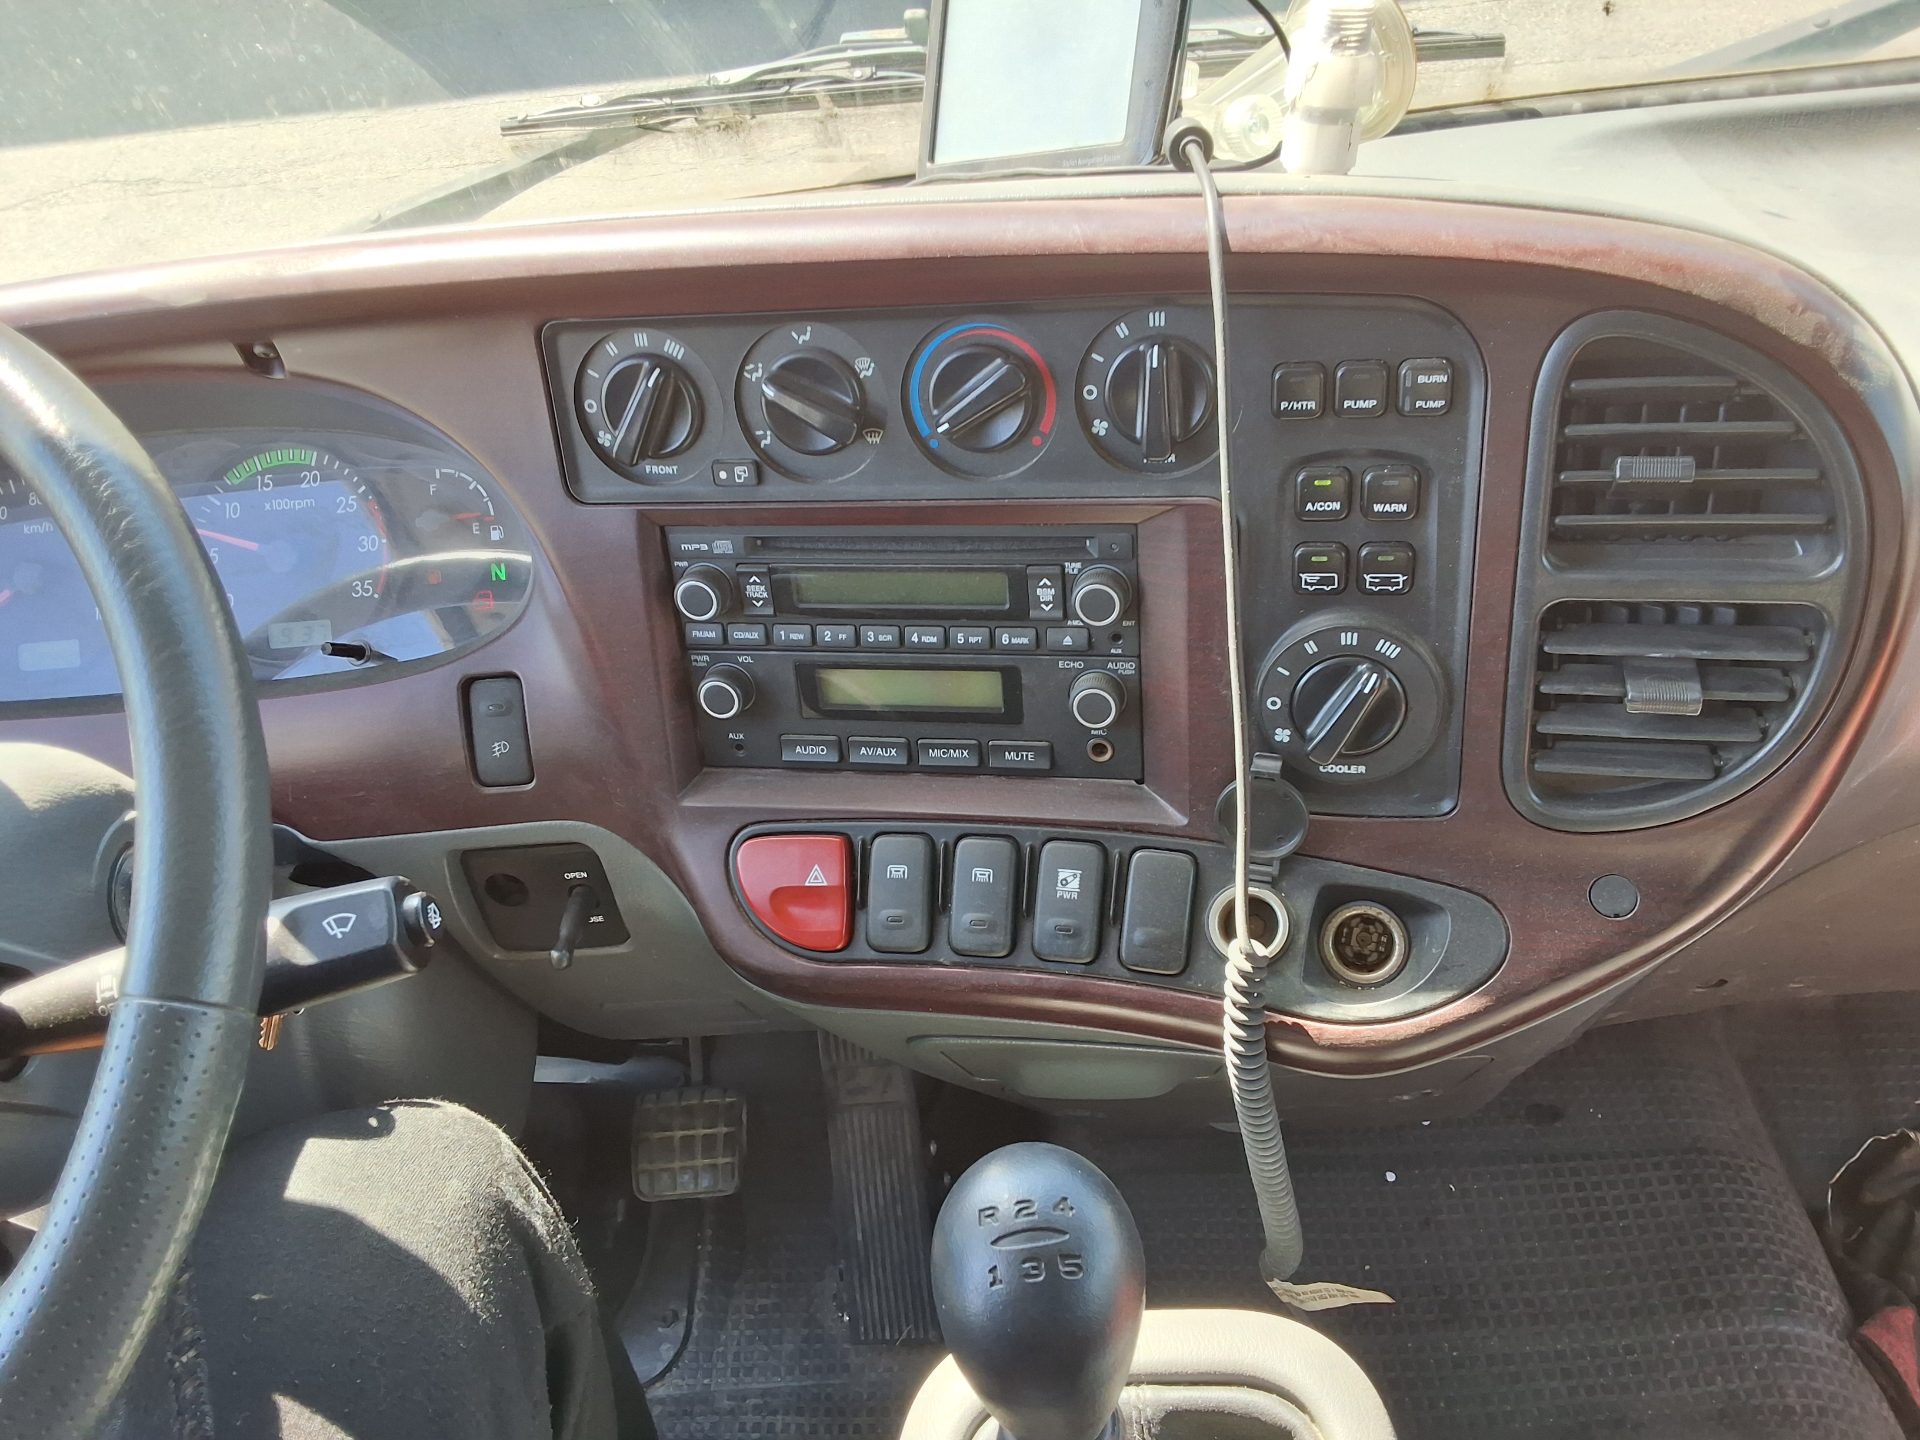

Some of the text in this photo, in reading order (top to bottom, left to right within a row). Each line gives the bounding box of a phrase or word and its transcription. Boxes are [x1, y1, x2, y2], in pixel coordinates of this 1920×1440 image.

[1417, 374, 1448, 384] BURN
[1280, 400, 1316, 411] P/HTR
[1343, 399, 1377, 409] PUMP
[1415, 400, 1446, 409] PUMP
[645, 465, 678, 475] FRONT
[256, 475, 273, 492] 15
[300, 471, 321, 488] 20
[429, 483, 437, 496] F
[264, 498, 315, 511] x100rpm
[336, 496, 357, 513] 25
[1305, 501, 1341, 511] A/CON
[1373, 503, 1408, 513] WARN
[225, 502, 240, 519] 10
[23, 521, 54, 535] km/h
[472, 522, 480, 534] E
[358, 535, 379, 552] 30
[490, 562, 507, 581] N
[351, 581, 373, 598] 35
[745, 591, 768, 599] TRACK
[733, 631, 760, 639] CD/AUX
[779, 630, 785, 641] 1
[824, 631, 831, 641] 2
[867, 632, 875, 642] 3
[911, 633, 937, 643] 4 RDM
[957, 634, 982, 644] 5 RPT
[1001, 634, 1030, 645] 6 MARK
[691, 654, 710, 663] PWR
[737, 655, 754, 663] VOL
[1058, 660, 1084, 669] ECHO
[1107, 661, 1136, 670] AUDIO
[728, 732, 744, 740] AUX
[795, 745, 827, 755] AUDIO
[859, 746, 897, 757] AV/AUX
[928, 748, 970, 759] MIC/MIX
[1004, 751, 1036, 761] MUTE
[564, 871, 588, 880] OPEN
[1056, 890, 1079, 900] PWR
[977, 1196, 1076, 1227] R 2 4
[987, 1253, 1084, 1290] 1 3 5
